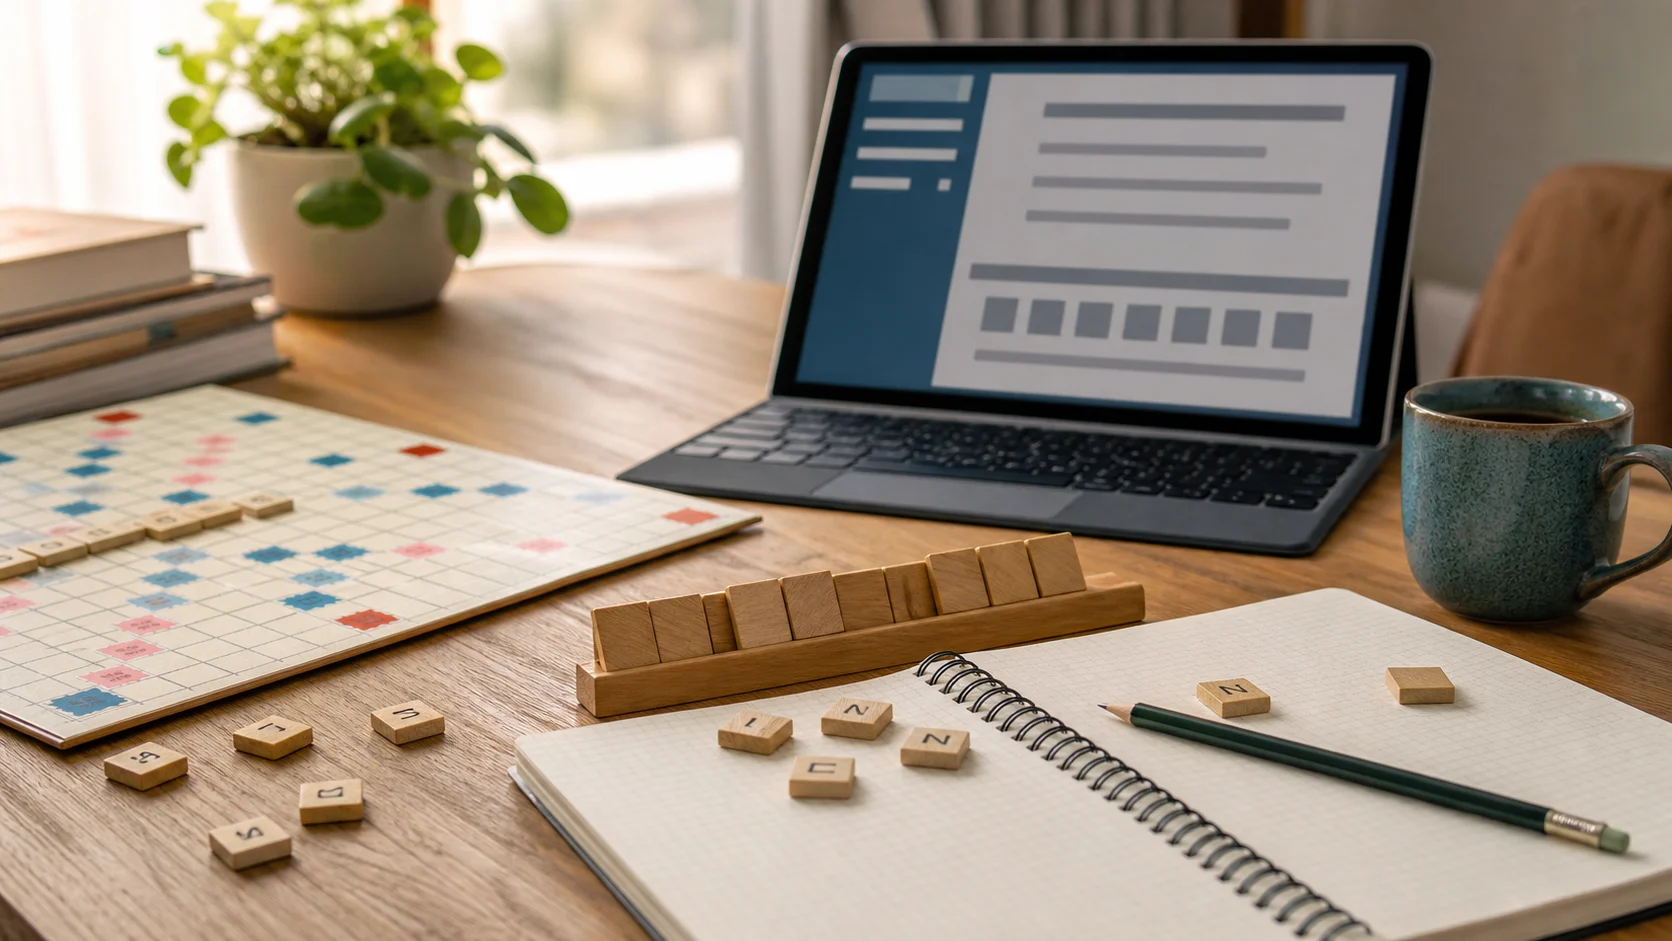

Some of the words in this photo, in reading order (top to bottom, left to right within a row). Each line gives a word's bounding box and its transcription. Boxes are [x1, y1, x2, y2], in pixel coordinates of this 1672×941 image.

[1219, 683, 1248, 695] N
[843, 703, 870, 716] N
[922, 732, 951, 746] N
